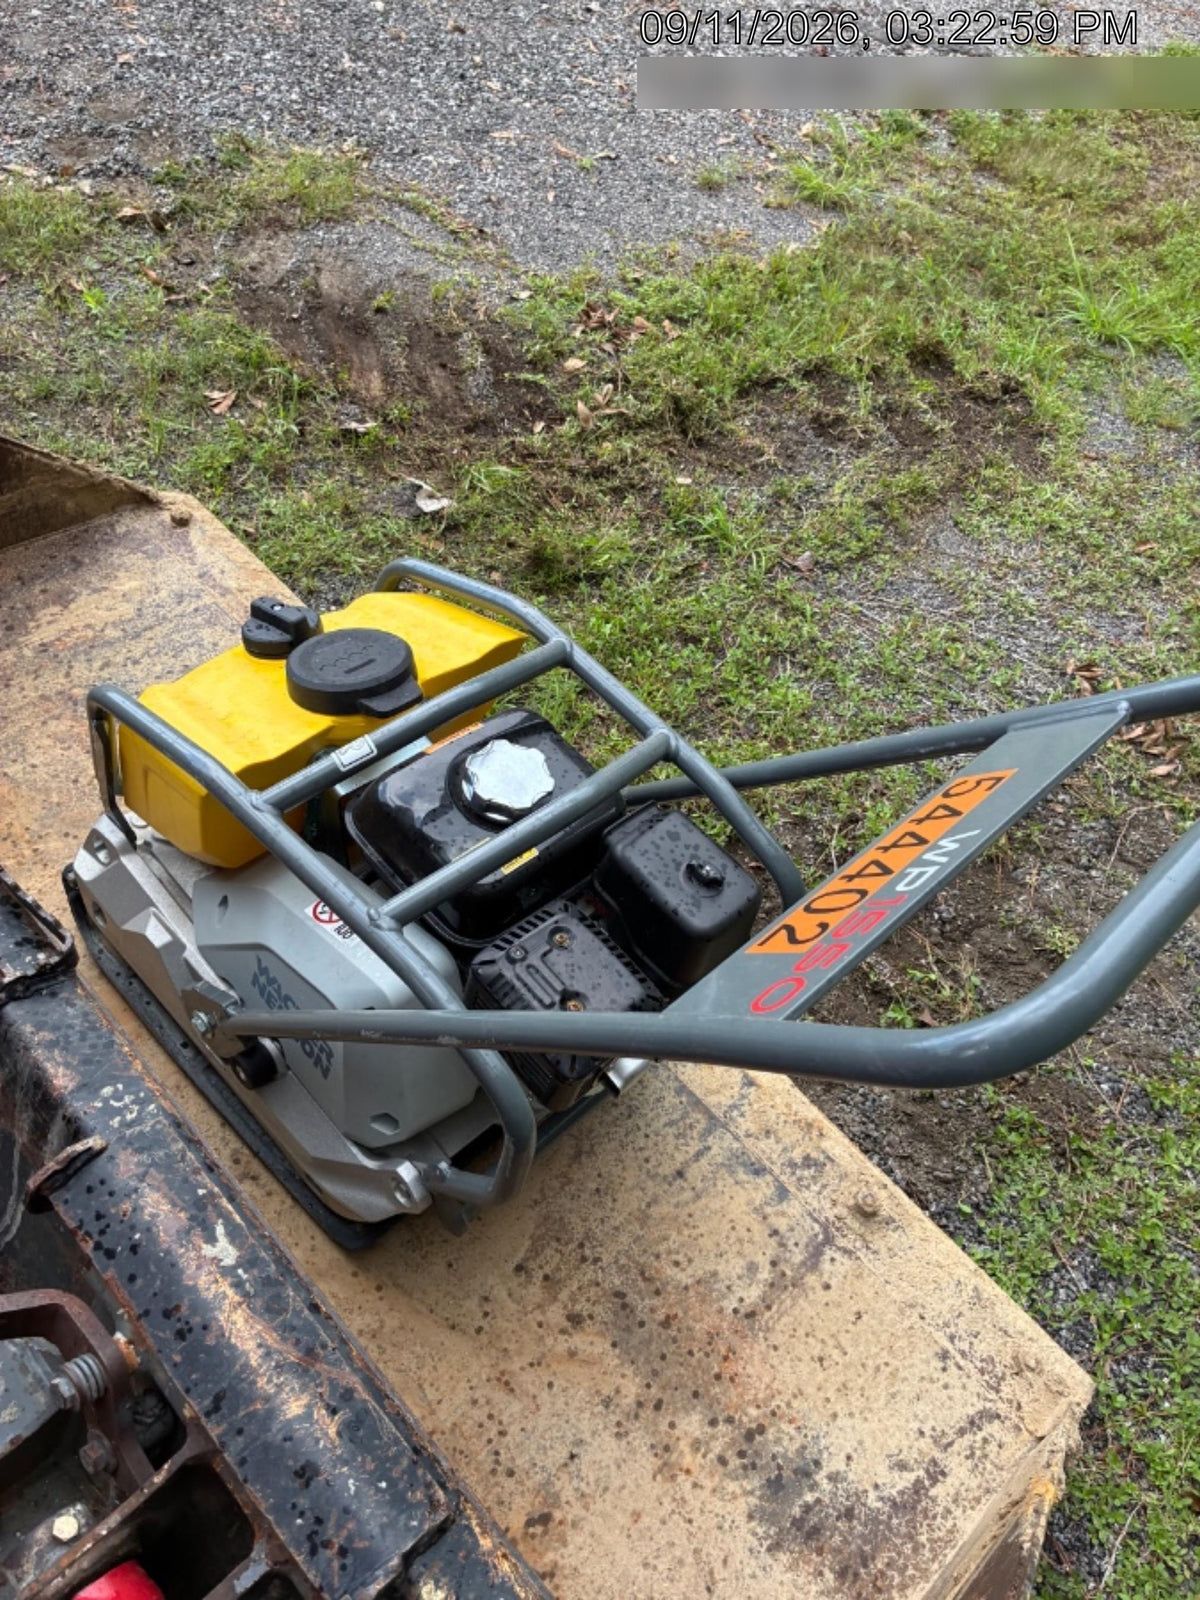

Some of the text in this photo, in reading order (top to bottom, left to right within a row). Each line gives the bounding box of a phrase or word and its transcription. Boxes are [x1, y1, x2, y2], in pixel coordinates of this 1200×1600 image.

[750, 828, 983, 1015] WP1550
[757, 775, 1006, 947] 544402
[251, 970, 330, 1081] NEON
